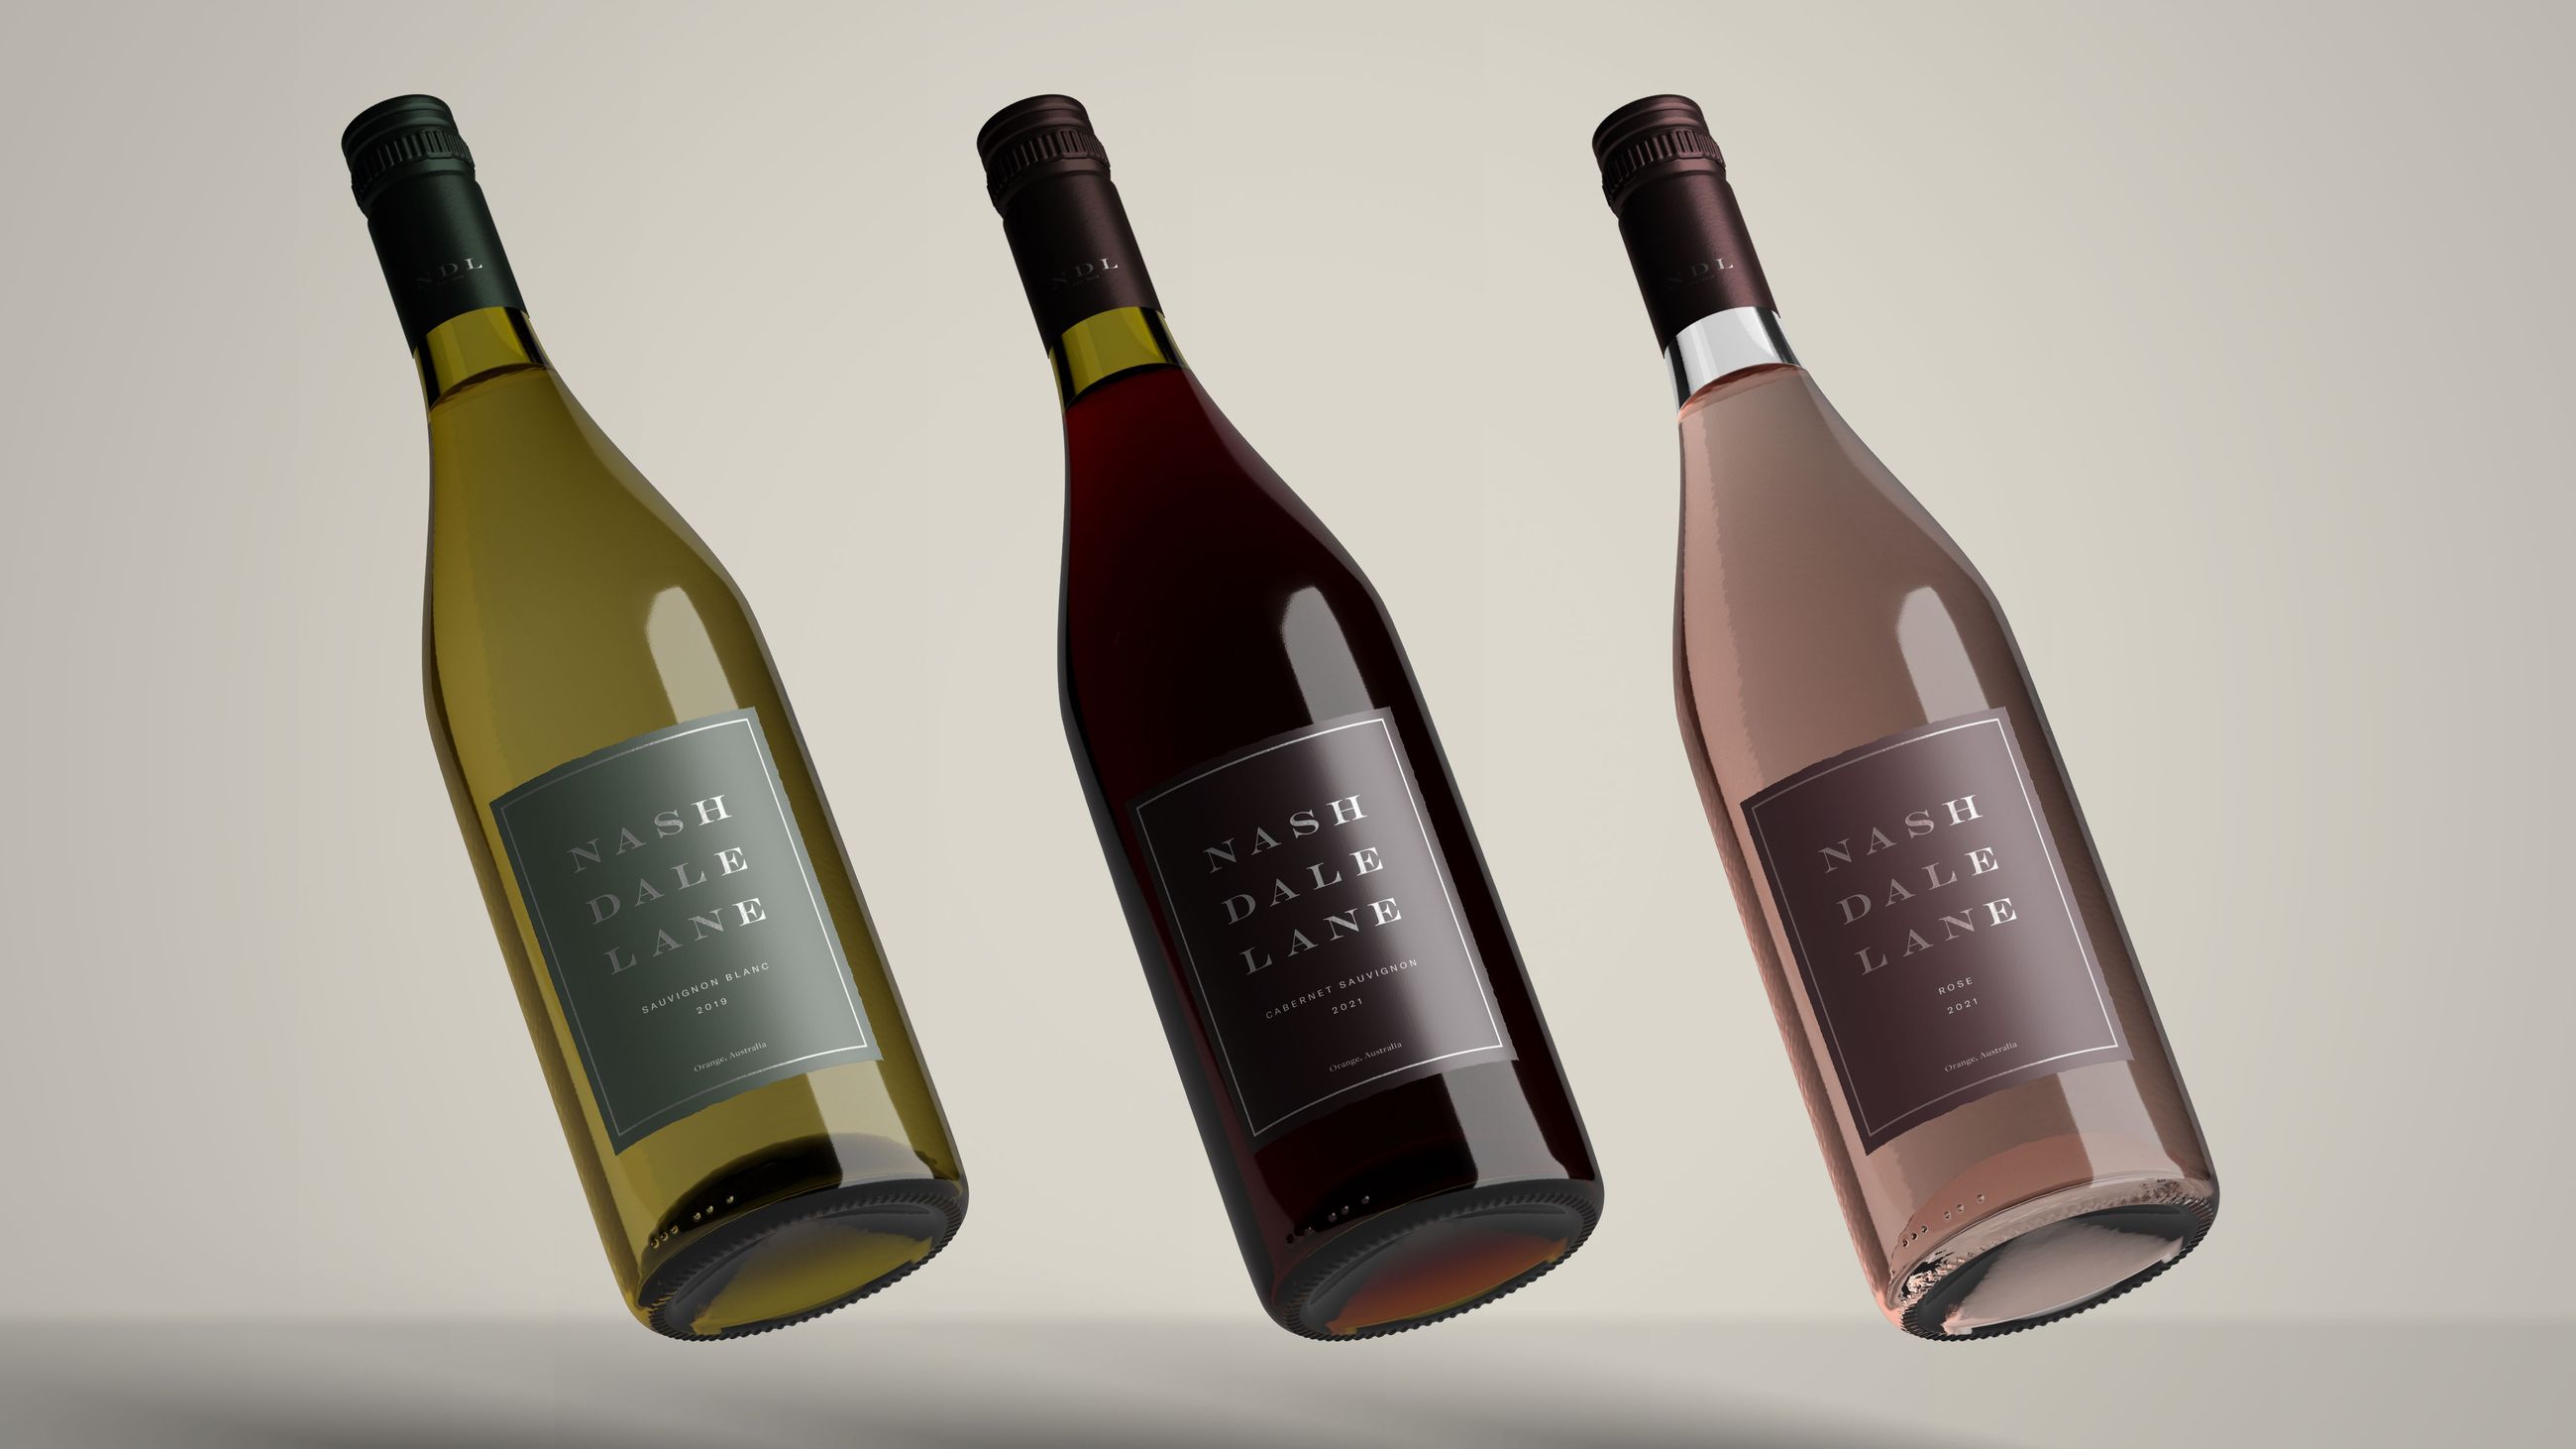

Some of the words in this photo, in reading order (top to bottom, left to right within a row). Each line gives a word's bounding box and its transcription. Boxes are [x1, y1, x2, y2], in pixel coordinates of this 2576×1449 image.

[567, 794, 732, 873] NASH
[1202, 794, 1368, 873] NASH
[1818, 794, 1984, 873] NASH
[586, 846, 749, 925] DALE
[1221, 846, 1384, 925] DALE
[1836, 846, 1999, 925] DALE
[603, 897, 767, 974] LANE
[1238, 897, 1402, 974] LANE
[1855, 897, 2018, 974] LANE
[641, 978, 719, 1014] SAUVIGNON
[725, 962, 771, 983] BLANC
[697, 997, 729, 1015] 2019
[1265, 985, 1333, 1020] CABERNET
[1339, 958, 1419, 990] SAUVIGNON
[1332, 997, 1363, 1015] 2021
[1938, 976, 1974, 995] ROSE
[1947, 997, 1979, 1015] 2021
[694, 1053, 727, 1072] Orange,
[728, 1041, 767, 1059] Australia
[1329, 1053, 1363, 1072] Orange,
[1364, 1041, 1403, 1059] Australia
[1944, 1053, 1979, 1072] Orange,
[1980, 1041, 2018, 1059] Australia
